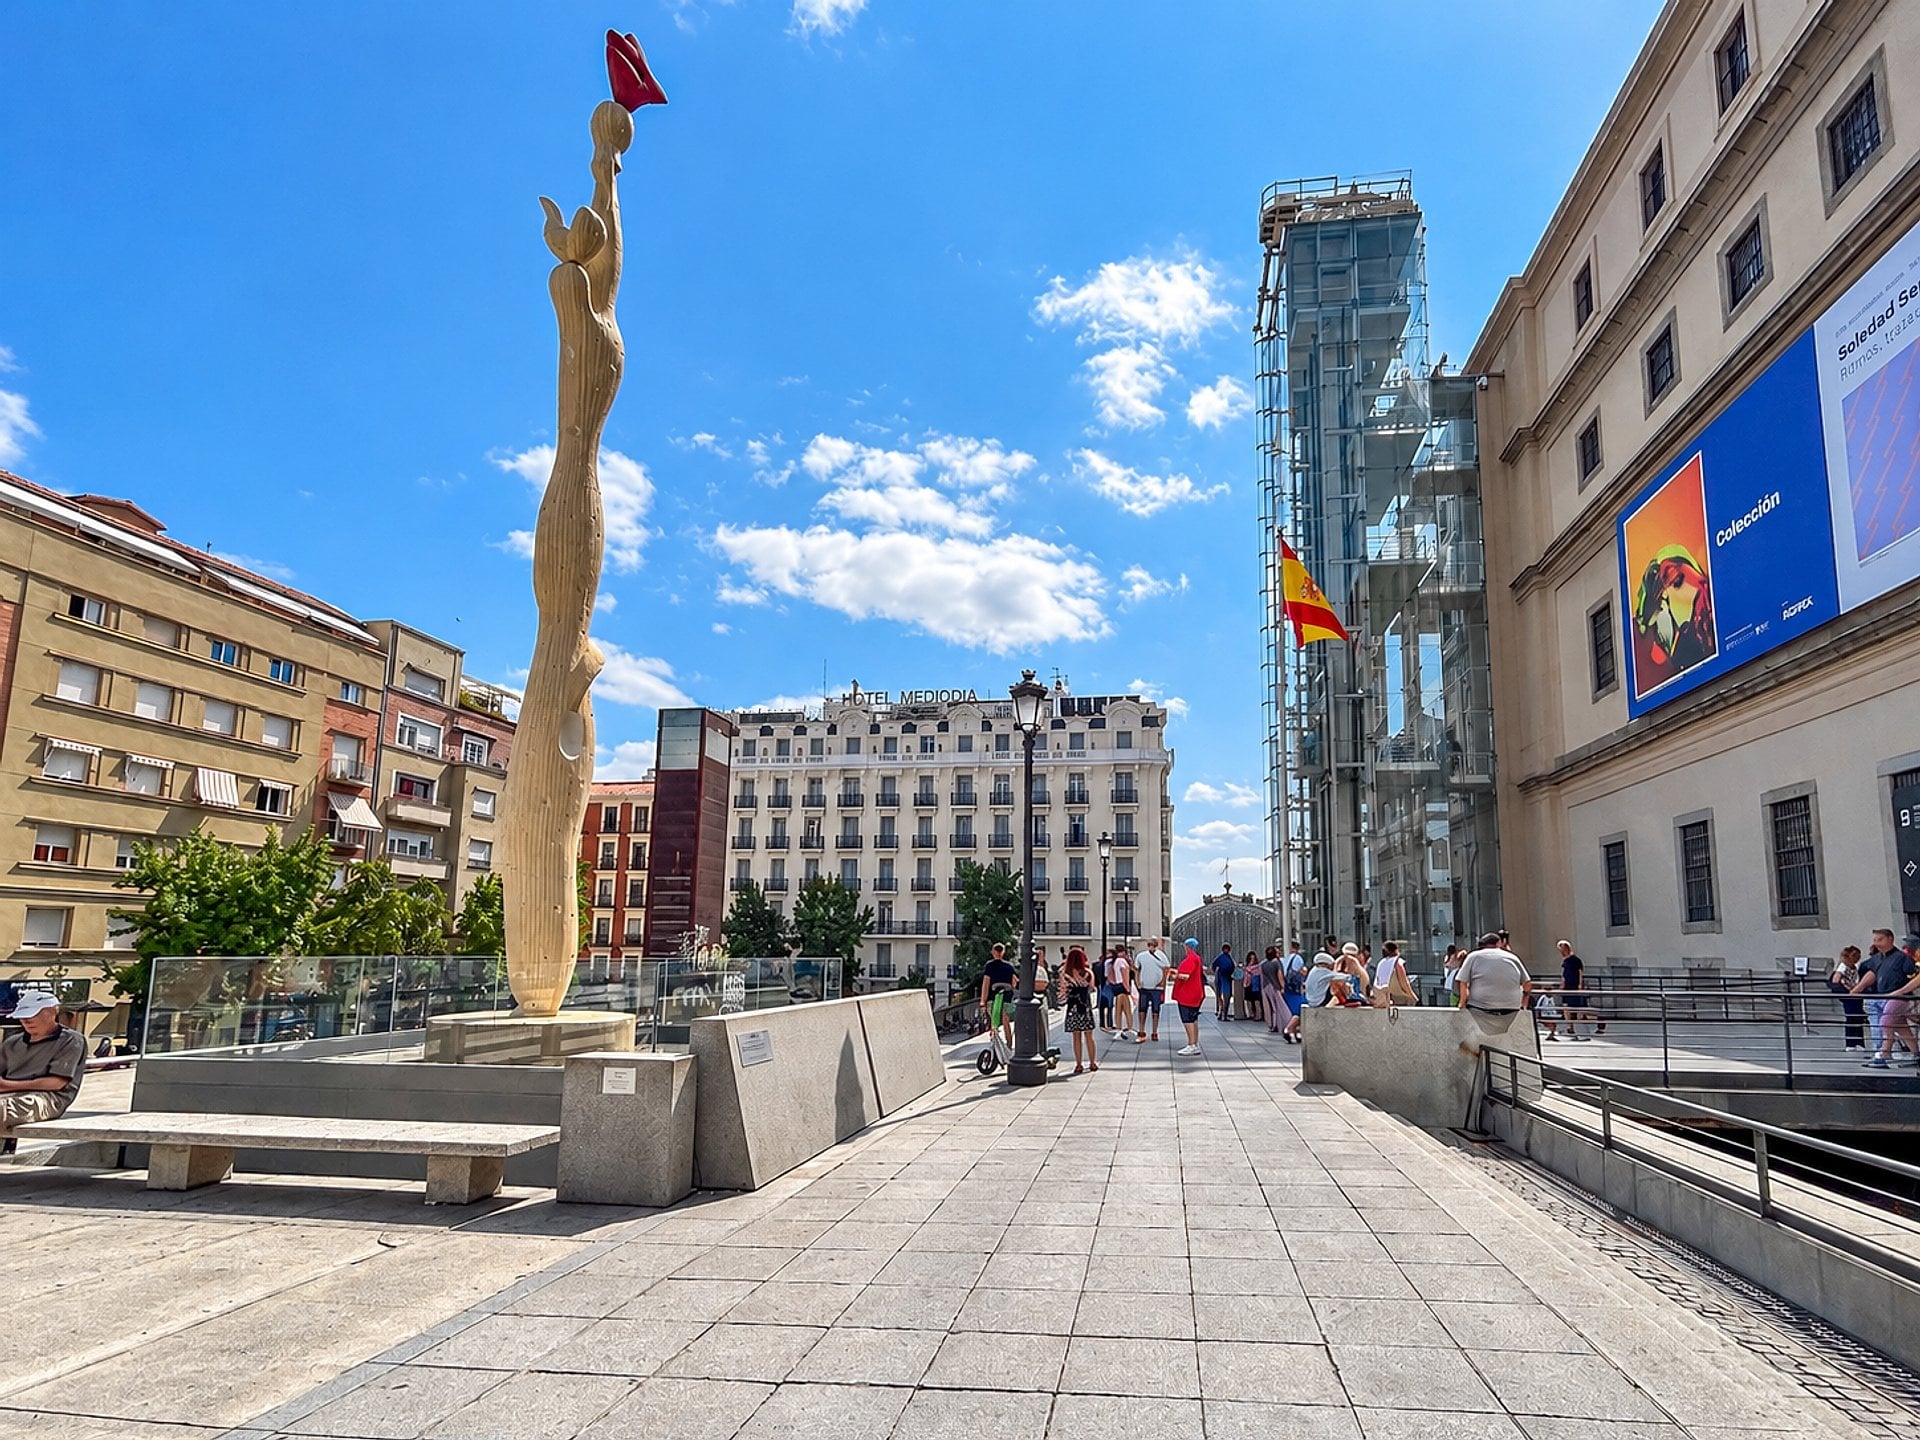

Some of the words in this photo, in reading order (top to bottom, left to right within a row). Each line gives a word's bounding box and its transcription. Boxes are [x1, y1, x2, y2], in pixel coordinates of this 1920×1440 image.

[1838, 299, 1895, 361] Soledad
[1898, 280, 1920, 308] Se
[1716, 491, 1780, 547] Colección
[842, 691, 893, 706] HOTEL
[900, 689, 978, 705] MEDIODIA
